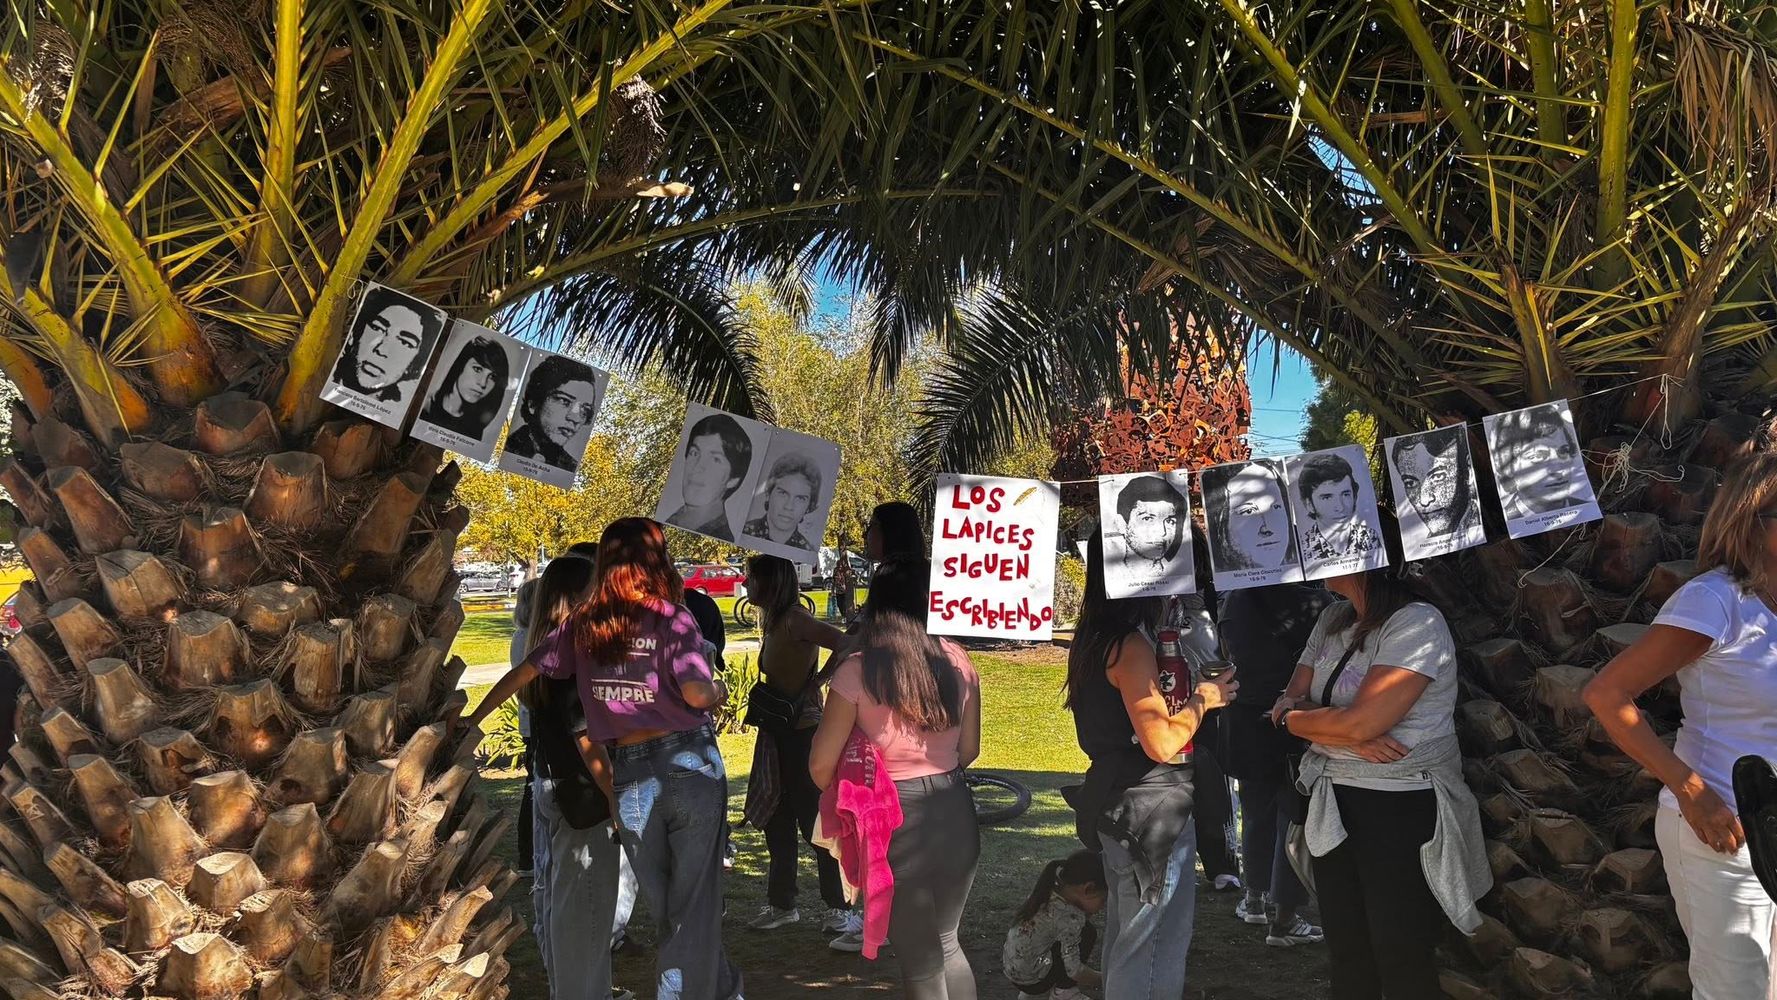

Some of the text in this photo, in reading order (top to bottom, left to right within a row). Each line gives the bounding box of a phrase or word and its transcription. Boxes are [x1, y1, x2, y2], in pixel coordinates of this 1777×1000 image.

[952, 484, 1006, 513] LOS
[942, 516, 1035, 551] LAPICES
[943, 553, 1030, 581] SIGUEN
[930, 591, 1052, 631] ESCRIBIENDO
[632, 638, 657, 650] ION
